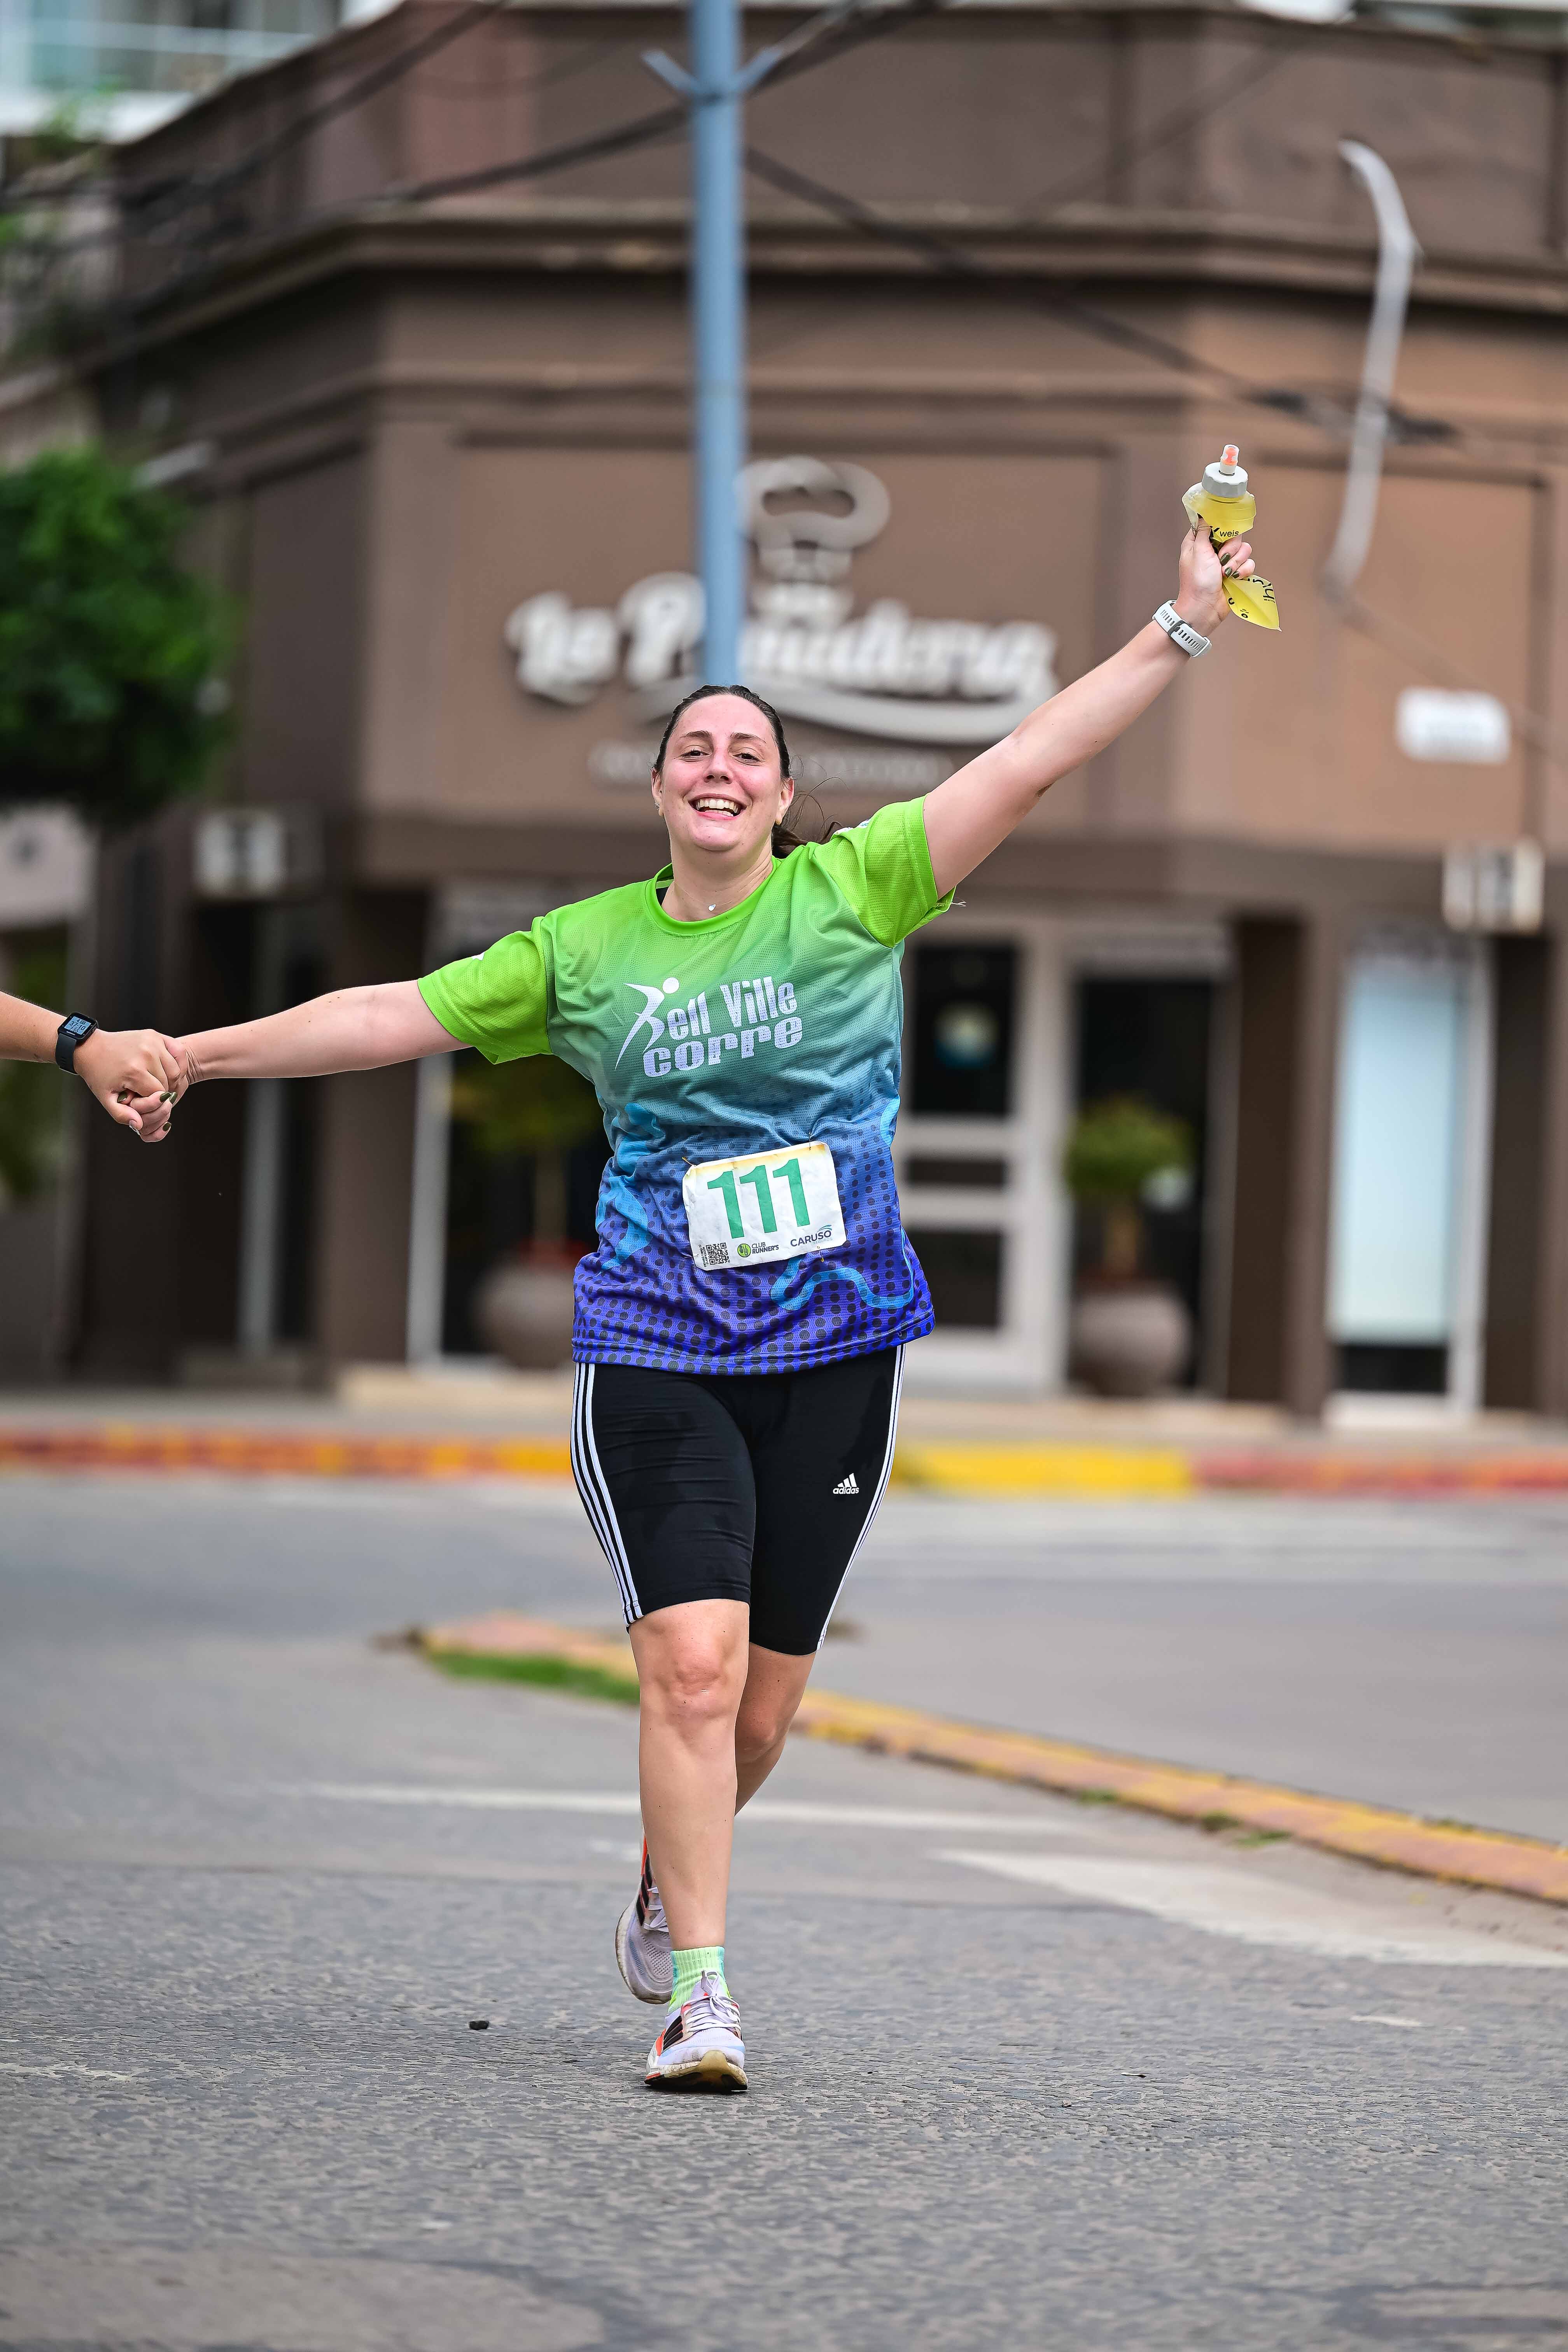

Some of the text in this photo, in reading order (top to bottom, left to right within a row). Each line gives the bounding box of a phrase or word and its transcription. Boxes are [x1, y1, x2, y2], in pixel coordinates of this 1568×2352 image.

[719, 976, 798, 1028] Ville
[69, 1021, 86, 1031] 37:10
[707, 1158, 810, 1239] 111
[790, 1230, 831, 1247] CARUSO
[752, 1244, 779, 1254] RUNNER'S
